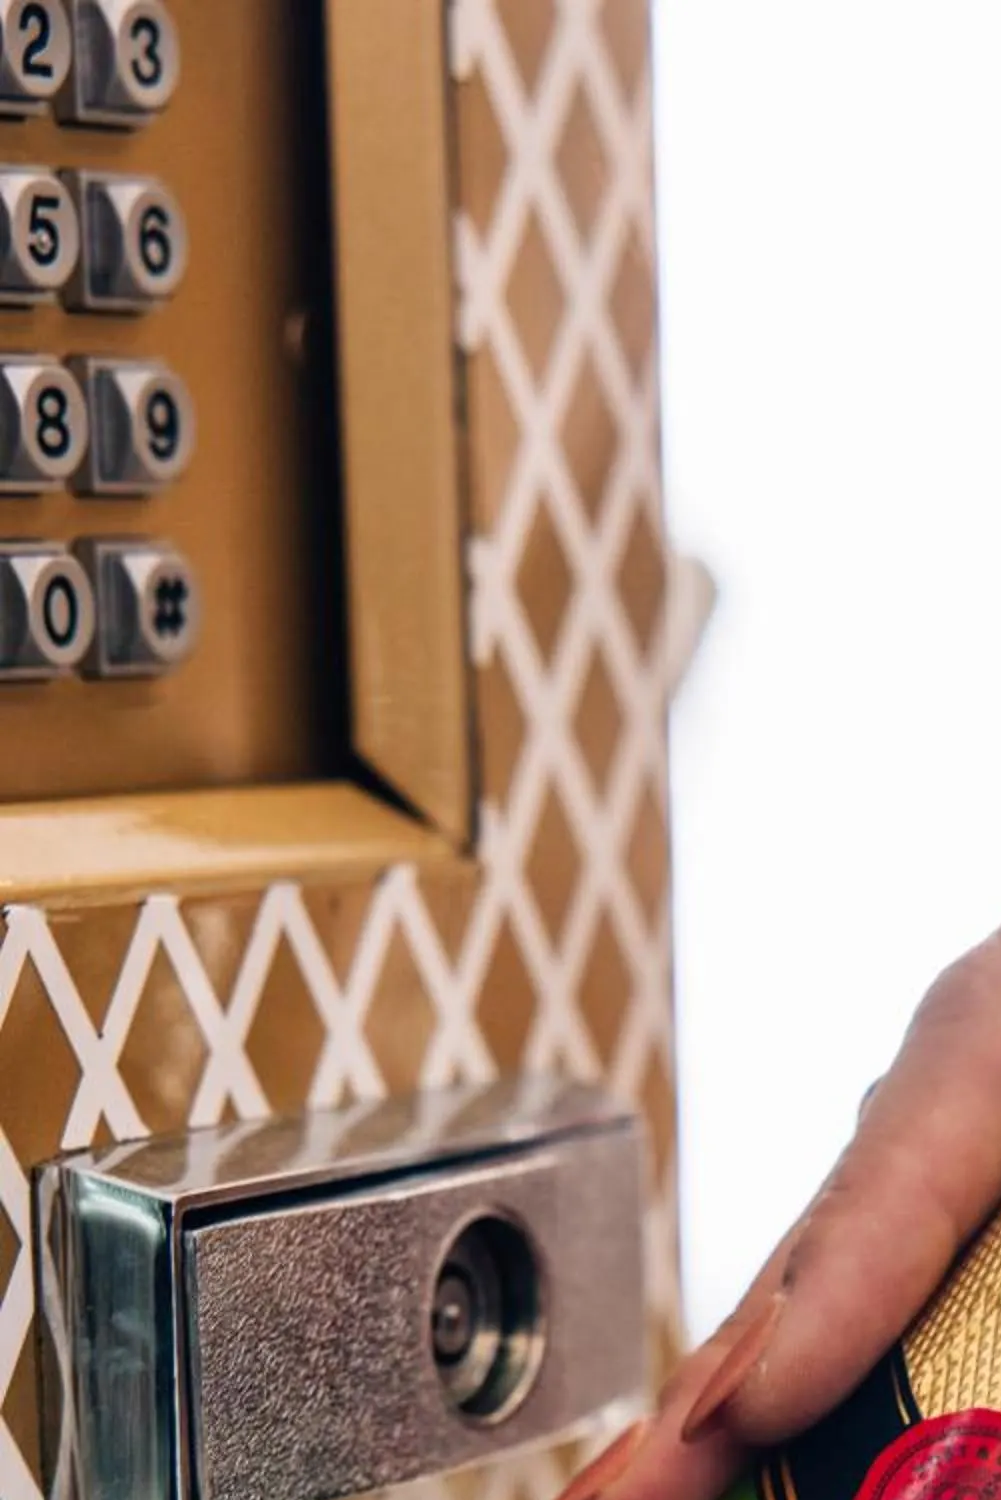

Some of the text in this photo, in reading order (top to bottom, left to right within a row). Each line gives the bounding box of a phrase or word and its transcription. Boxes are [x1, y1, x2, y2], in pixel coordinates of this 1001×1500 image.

[18, 2, 53, 77] 2
[130, 16, 162, 88] 3
[27, 196, 61, 266] 5
[138, 204, 171, 277] 6
[35, 386, 70, 459] 8
[146, 388, 178, 462] 9
